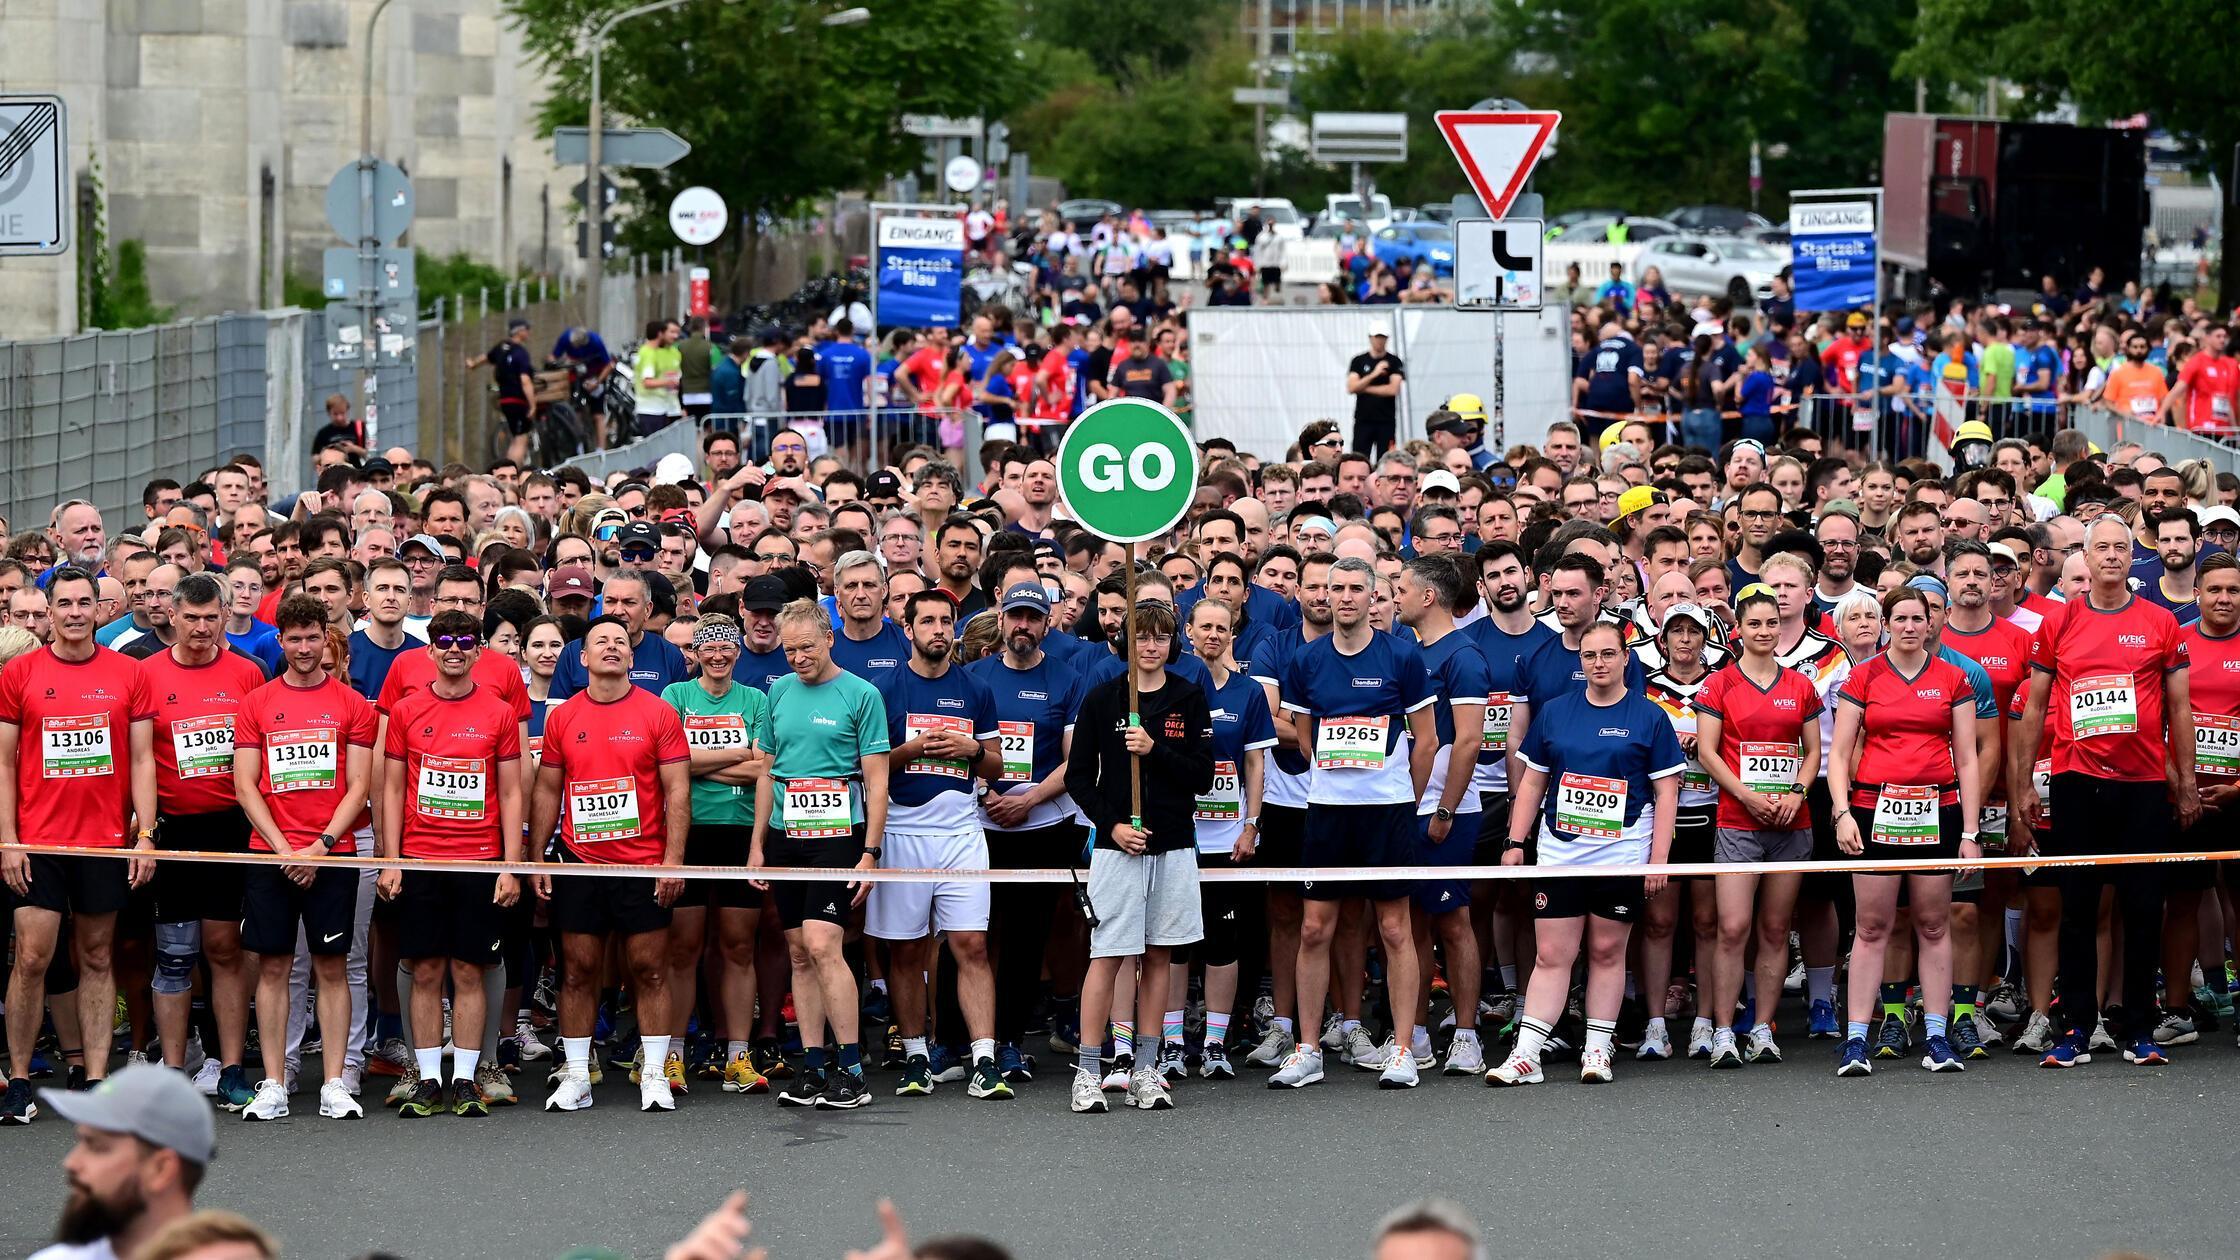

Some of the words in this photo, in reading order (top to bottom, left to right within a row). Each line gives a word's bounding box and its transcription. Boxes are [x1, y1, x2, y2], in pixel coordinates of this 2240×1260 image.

[1800, 209, 1866, 226] EINGANG
[889, 227, 955, 241] EINGANG
[1800, 240, 1866, 256] Startzeit
[887, 255, 953, 272] Startzeit
[1815, 256, 1850, 271] Blau
[902, 270, 937, 287] Blau
[1078, 441, 1176, 492] GO
[1011, 590, 1042, 600] adidas
[2118, 634, 2146, 644] WEIG
[1980, 656, 2007, 665] WEIG
[1916, 688, 1941, 697] WEIG
[2075, 690, 2128, 709] 20144
[813, 715, 837, 726] imbus
[1164, 721, 1185, 729] ORCA
[51, 730, 104, 747] 13106
[183, 730, 235, 748] 13082
[690, 730, 741, 745] 10133
[1164, 729, 1185, 738] TEAM
[1326, 727, 1379, 741] 19265
[1000, 737, 1025, 752] 22
[275, 744, 329, 762] 13104
[1749, 758, 1794, 773] 20127
[426, 771, 478, 789] 13103
[578, 794, 628, 812] 13107
[791, 794, 842, 808] 10135
[1565, 789, 1618, 809] 19209
[588, 810, 619, 818] VIACHESLAV
[1575, 806, 1604, 814] FRANZISKA
[1882, 799, 1931, 815] 20134
